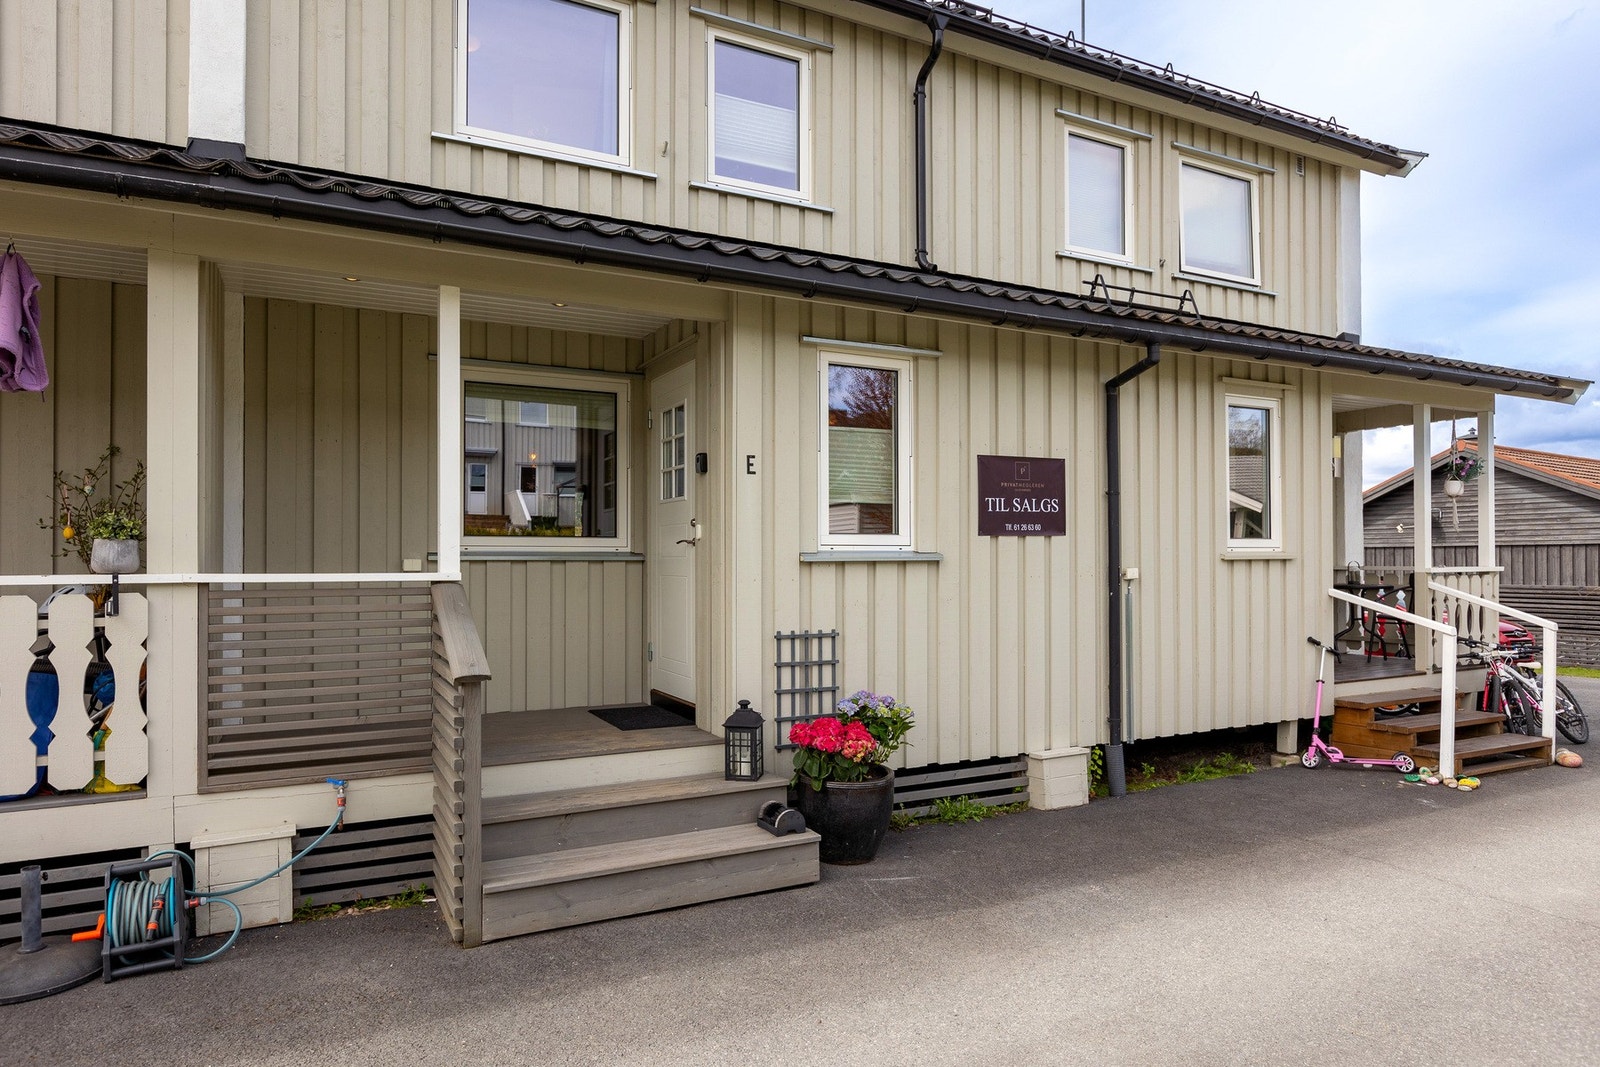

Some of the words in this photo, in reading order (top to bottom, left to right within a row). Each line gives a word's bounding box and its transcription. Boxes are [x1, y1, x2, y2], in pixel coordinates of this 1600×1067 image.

[746, 454, 757, 475] E
[985, 497, 1010, 512] TIL
[1012, 497, 1059, 513] SALGS
[1013, 523, 1020, 531] 61
[1020, 523, 1028, 531] 26
